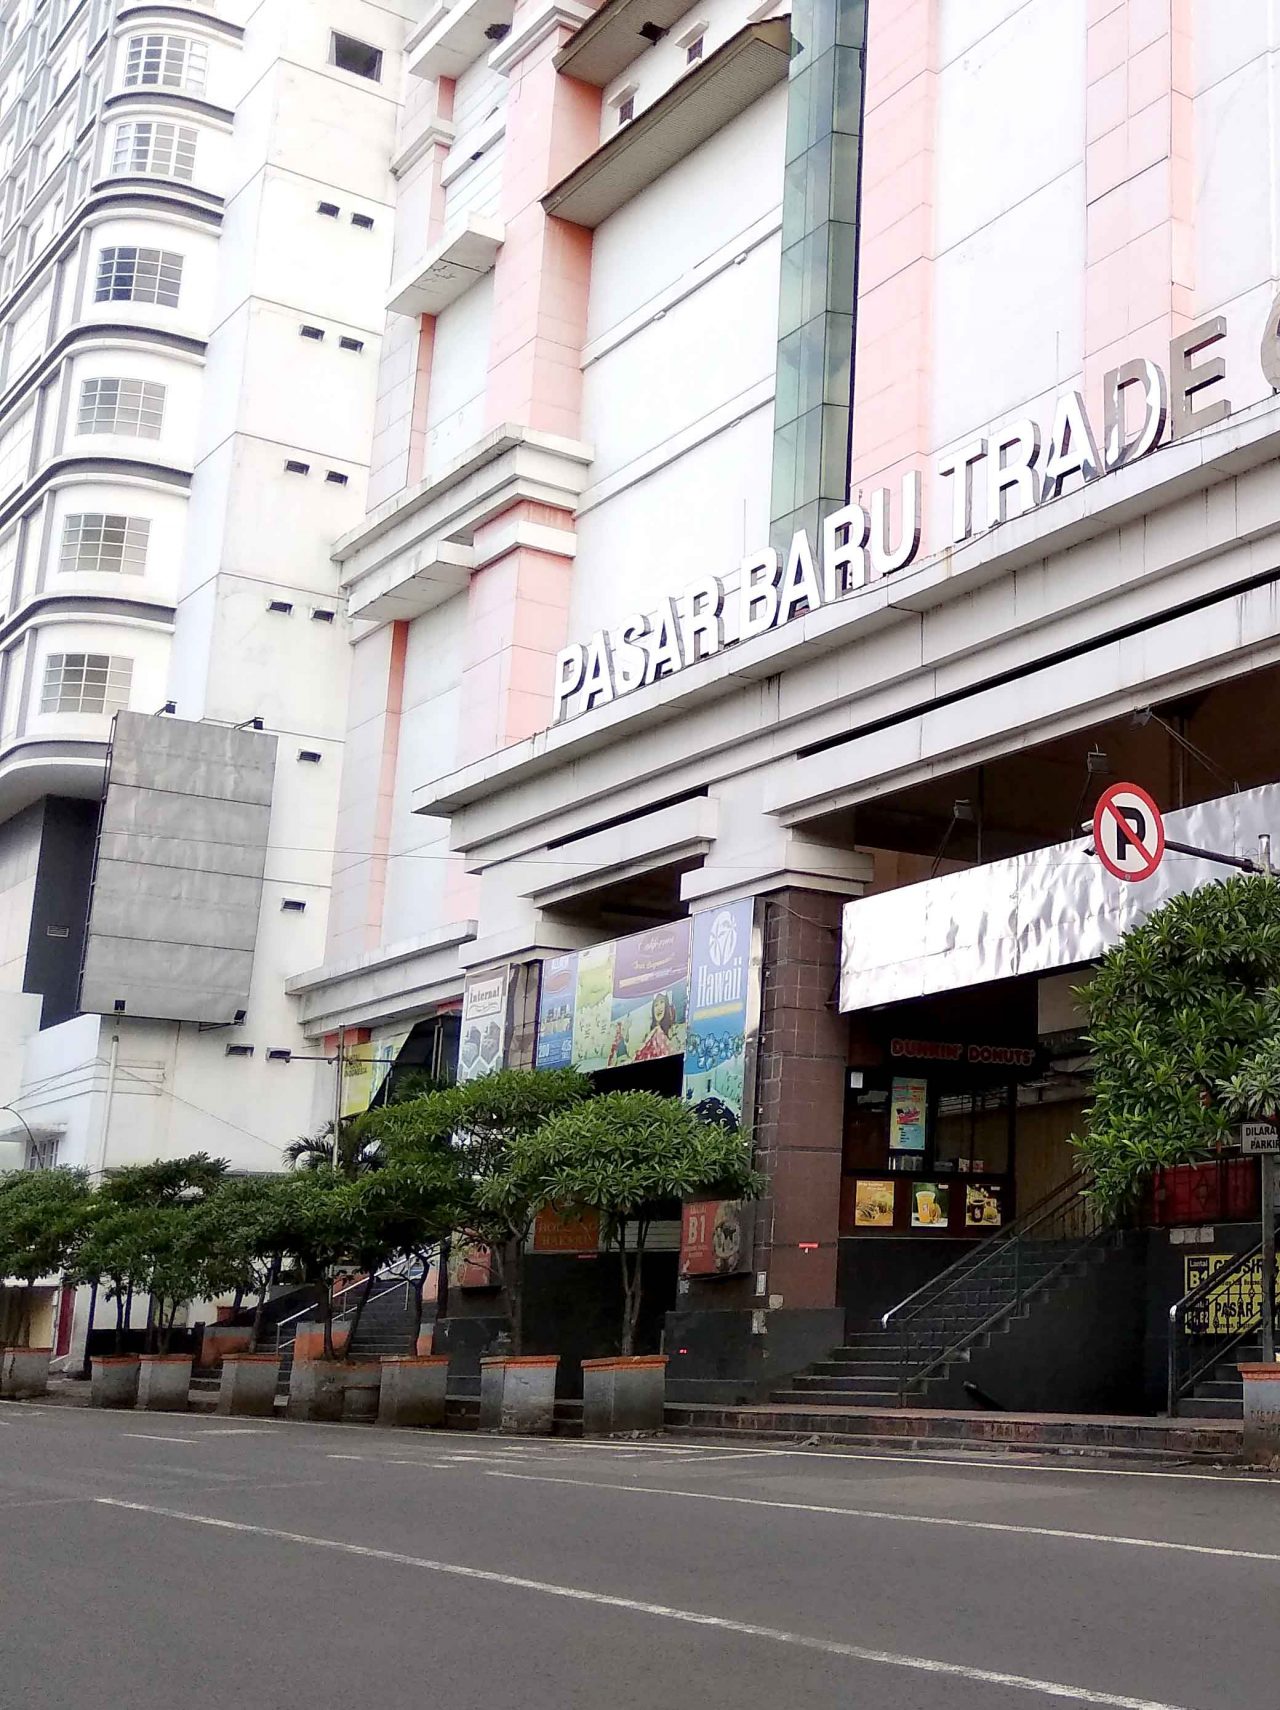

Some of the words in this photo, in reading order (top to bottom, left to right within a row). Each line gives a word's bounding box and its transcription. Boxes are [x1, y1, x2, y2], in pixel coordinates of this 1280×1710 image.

[553, 574, 740, 727] PASAR
[740, 470, 922, 633] BARU
[938, 315, 1232, 545] TRADE
[697, 957, 742, 1008] Hawaii
[1245, 1126, 1279, 1137] DILARA
[687, 1215, 706, 1244] B1
[1215, 1301, 1254, 1318] PASAR
